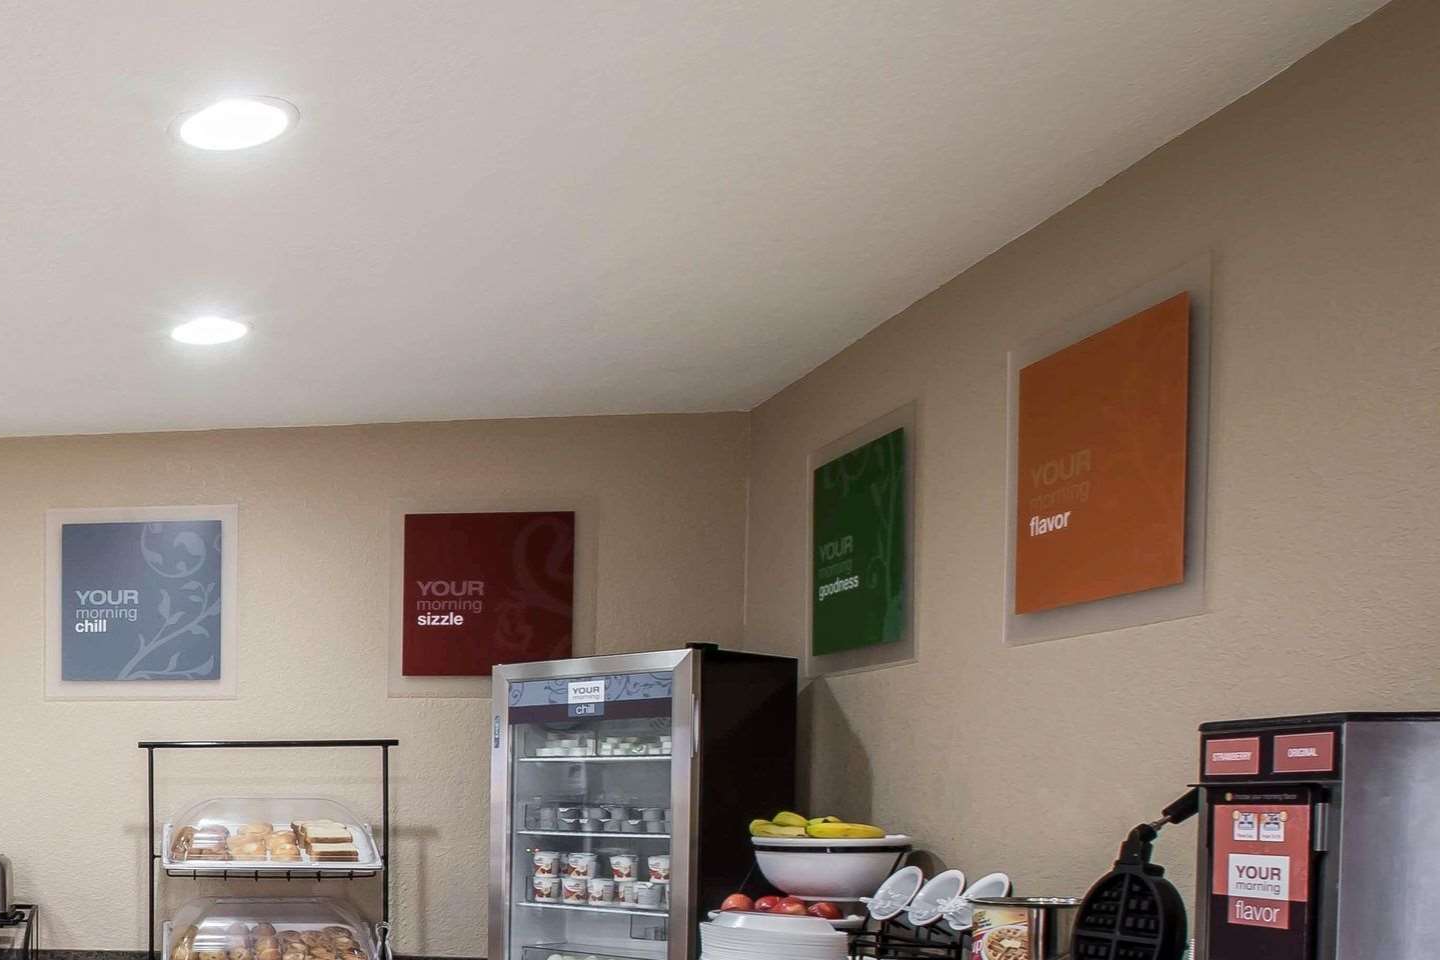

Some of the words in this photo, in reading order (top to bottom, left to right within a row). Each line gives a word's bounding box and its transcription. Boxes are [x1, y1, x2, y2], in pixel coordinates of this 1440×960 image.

[1030, 448, 1091, 489] YOUR
[1029, 511, 1072, 537] flavor
[819, 535, 854, 563] YOUR
[416, 580, 485, 596] YOUR
[819, 575, 859, 602] goodness
[75, 589, 139, 605] YOUR
[76, 606, 138, 622] morning
[417, 598, 482, 614] morning
[75, 619, 107, 633] chill
[417, 611, 464, 626] sizzle
[572, 686, 600, 695] YOUR
[575, 703, 595, 715] chill
[1235, 865, 1281, 881] YOUR
[1236, 881, 1280, 896] morning
[1235, 900, 1281, 923] flavor
